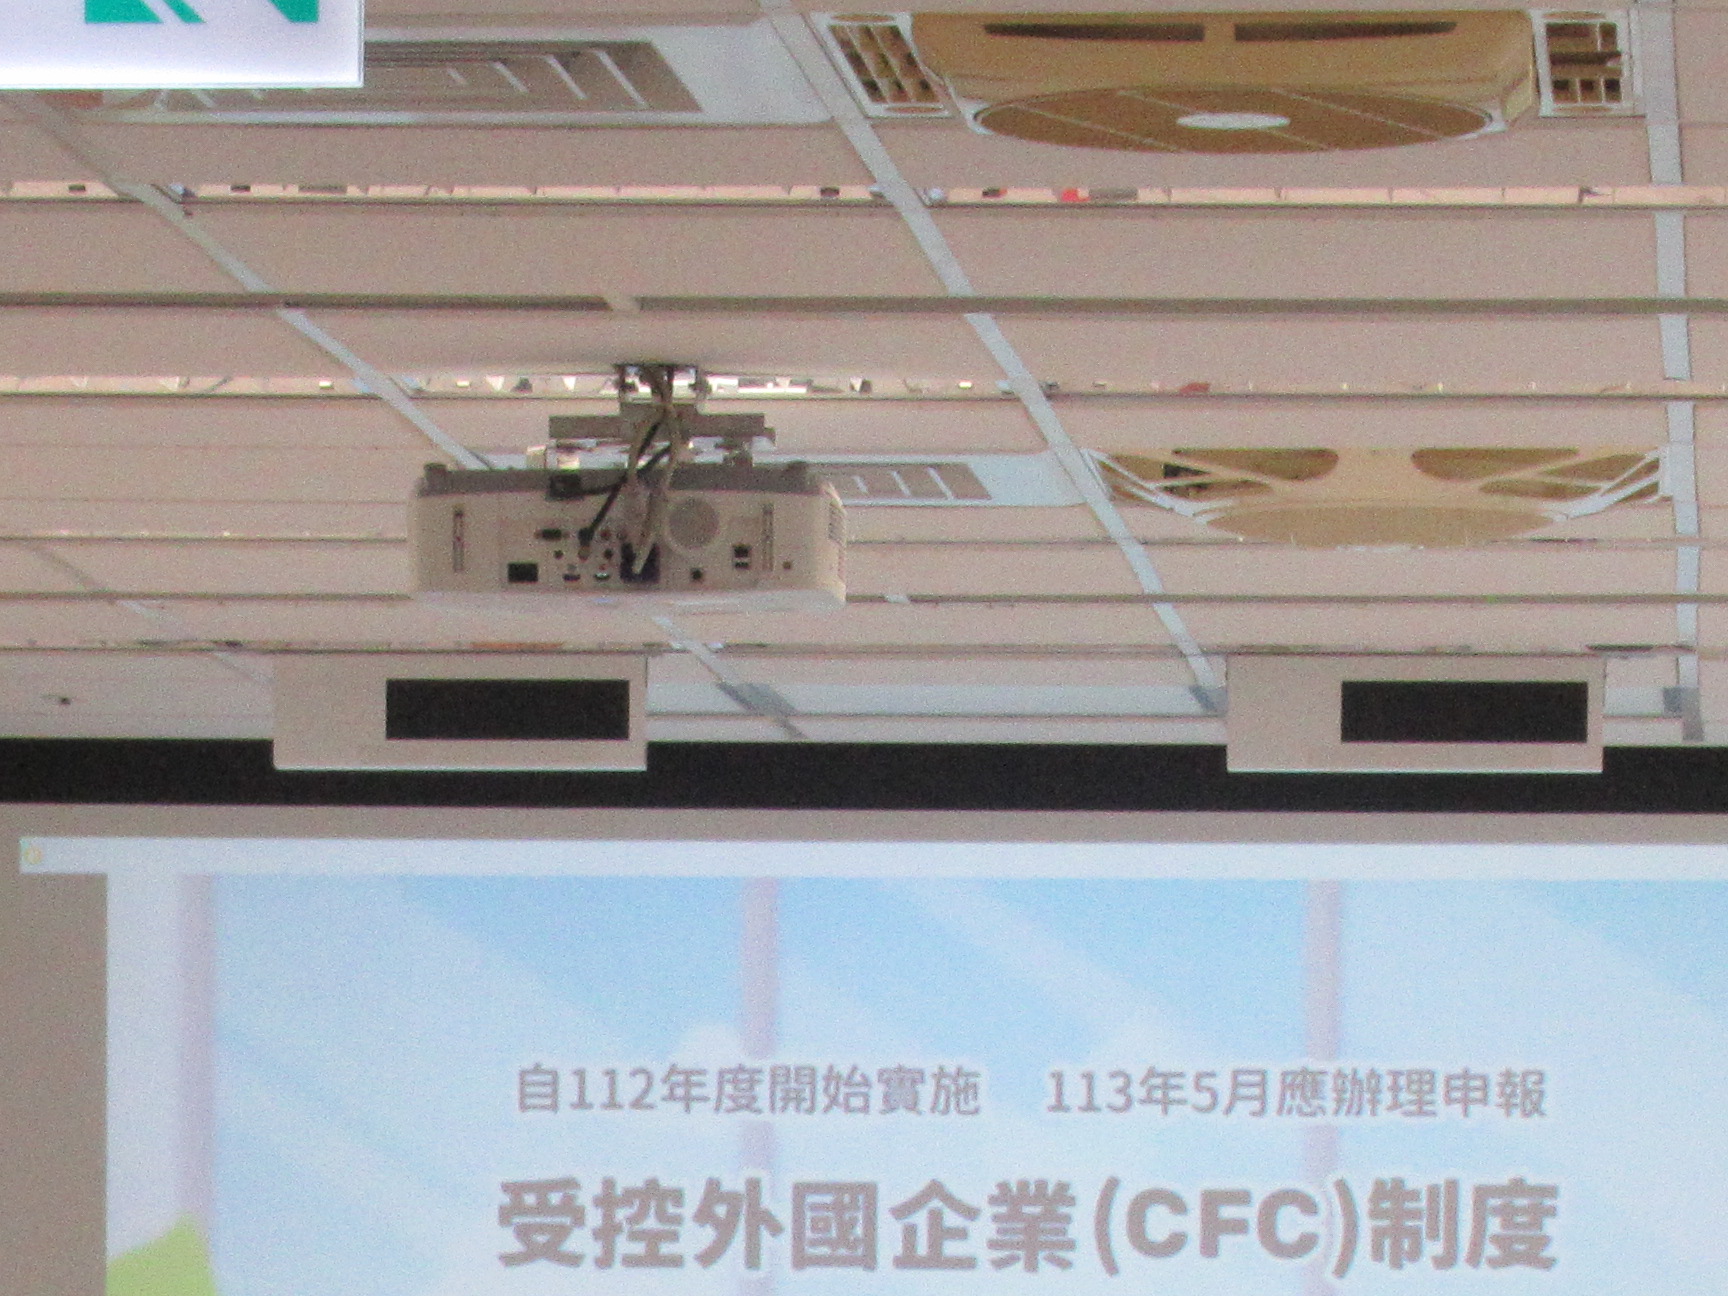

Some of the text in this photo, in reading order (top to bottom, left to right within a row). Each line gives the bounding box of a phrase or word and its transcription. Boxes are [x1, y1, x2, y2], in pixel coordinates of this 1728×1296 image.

[514, 1062, 1549, 1121] 自112年度開始實施 113年5月應辦理申報
[496, 1173, 1561, 1278] 受控外國企業(CFC)制度
